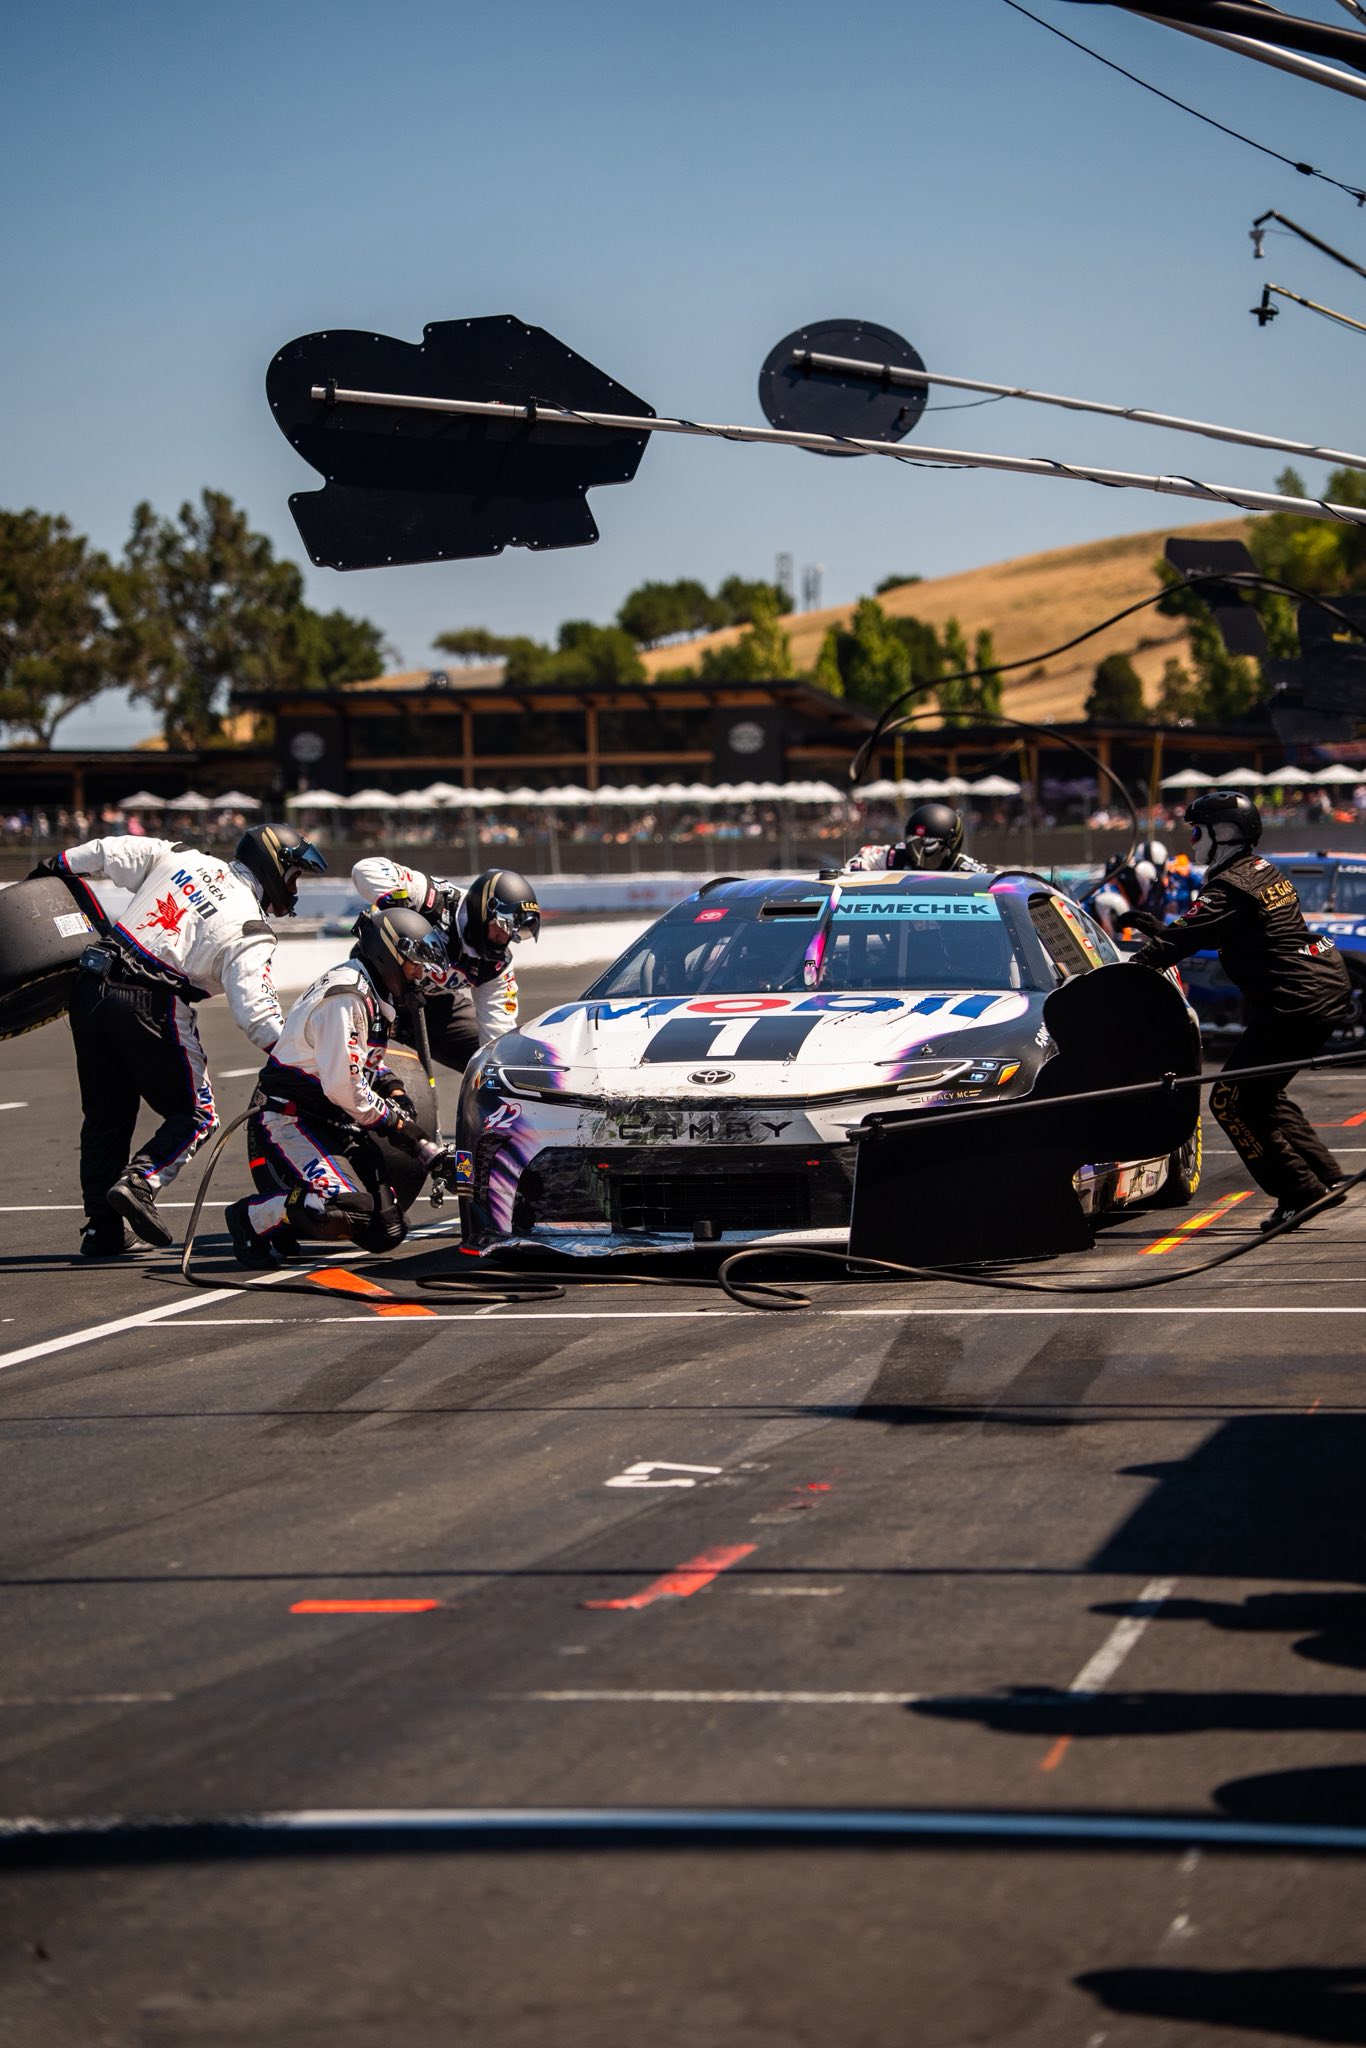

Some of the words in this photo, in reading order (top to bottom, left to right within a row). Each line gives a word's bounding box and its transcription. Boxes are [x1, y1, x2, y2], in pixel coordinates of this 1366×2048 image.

[196, 867, 227, 902] HOEN
[834, 903, 991, 915] NEMECHEK
[538, 994, 1005, 1027] Mobil
[708, 1018, 751, 1057] 1
[920, 1093, 954, 1103] LEGACY
[956, 1090, 970, 1099] MC
[484, 1103, 522, 1130] 42
[618, 1121, 794, 1141] CAMRY
